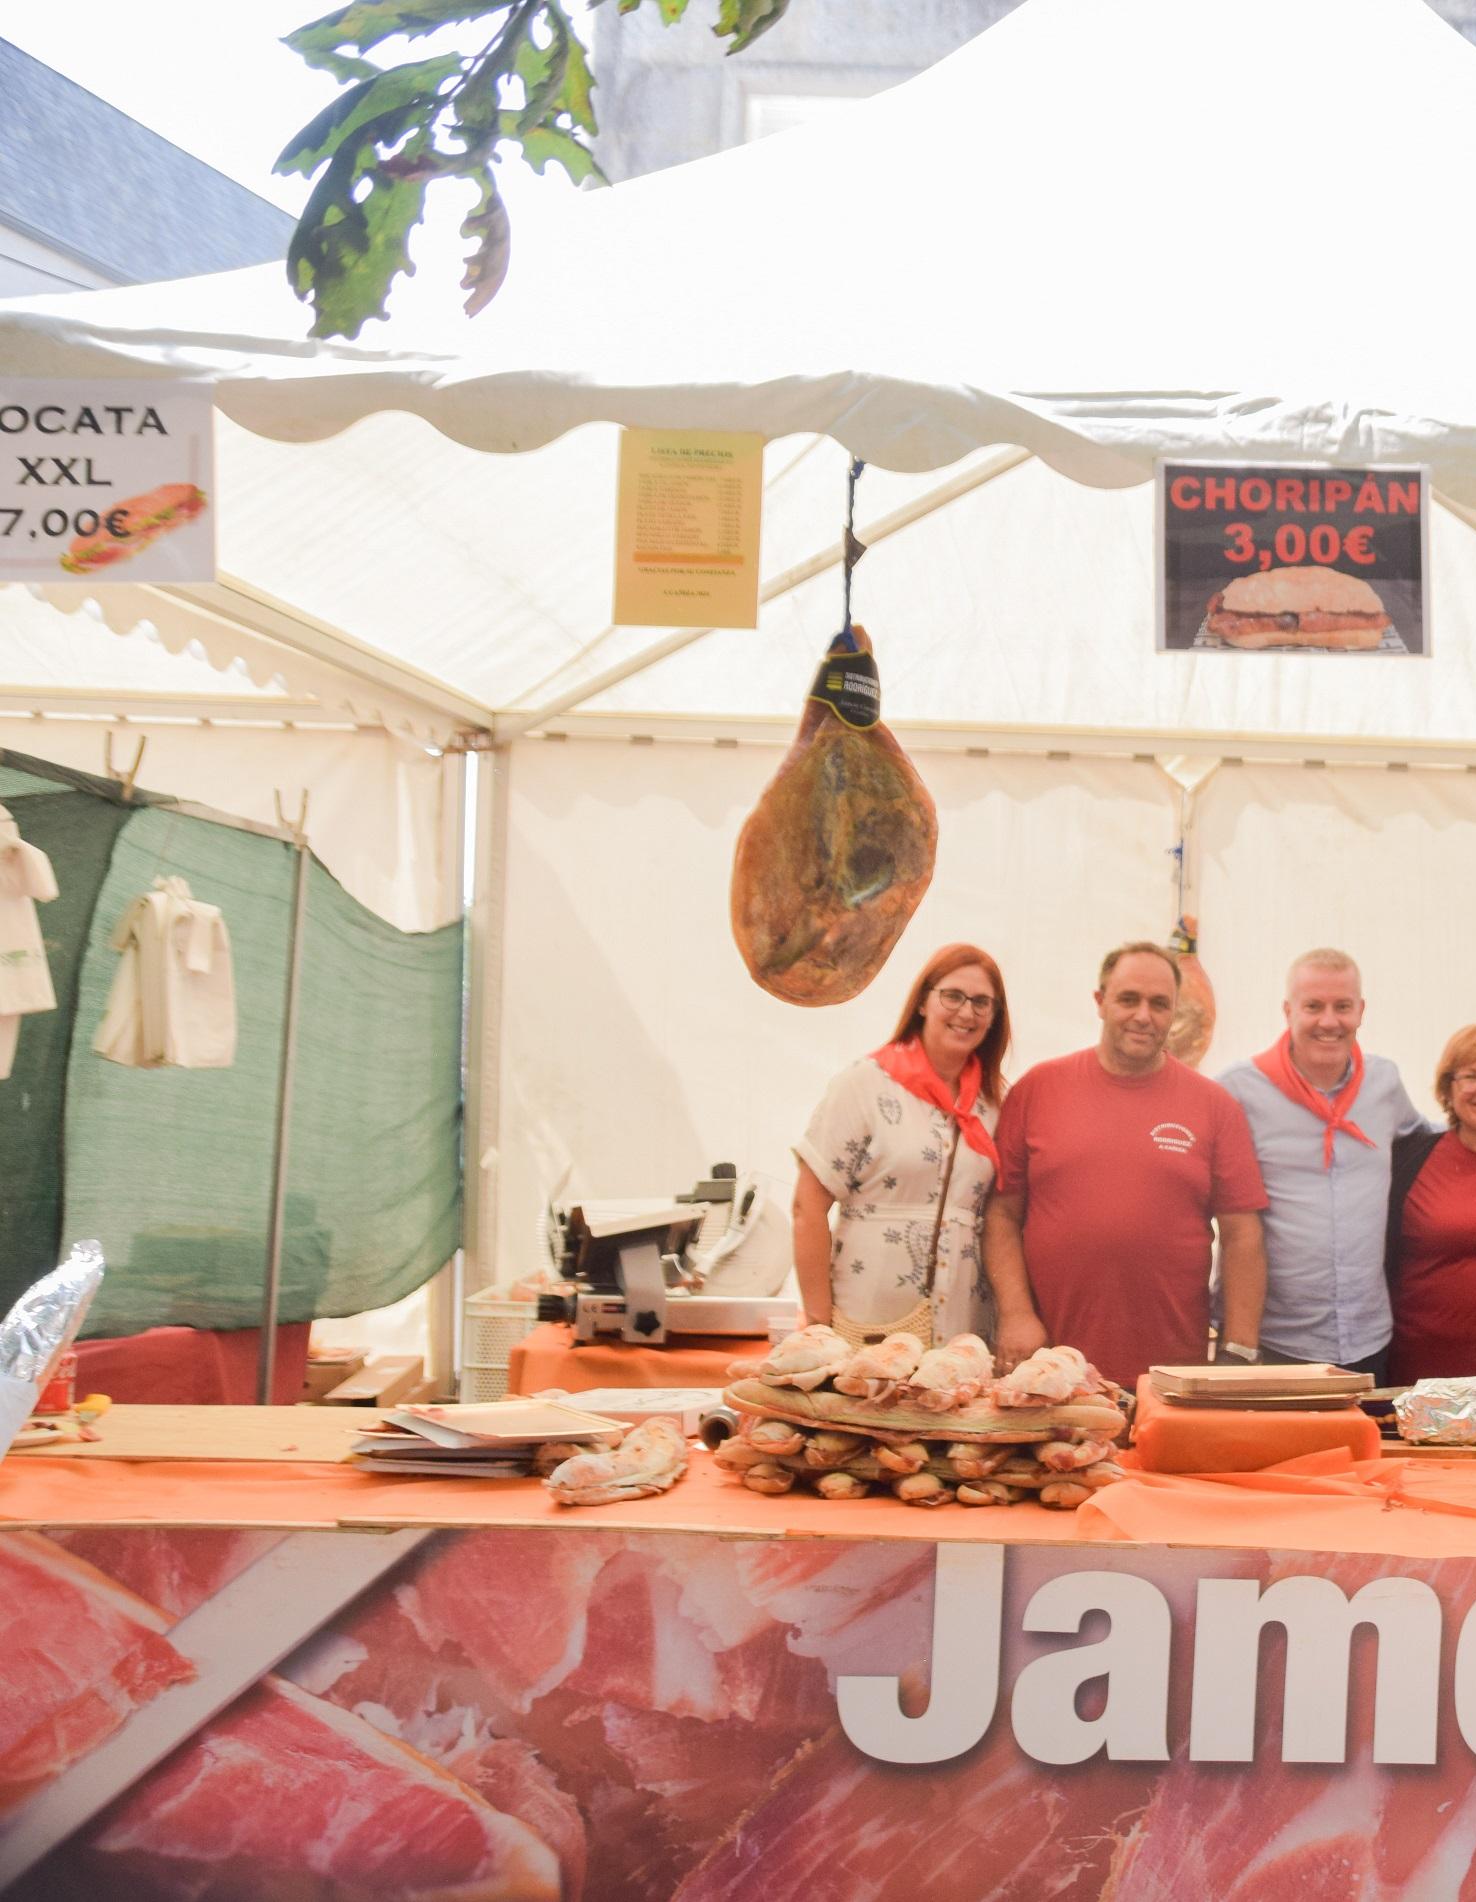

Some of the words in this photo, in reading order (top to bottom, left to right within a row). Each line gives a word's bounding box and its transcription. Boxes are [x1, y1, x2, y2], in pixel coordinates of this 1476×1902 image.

[17, 457, 112, 486] XXL
[1170, 473, 1419, 514] CHORIPÁN
[1223, 523, 1376, 570] 3,00€
